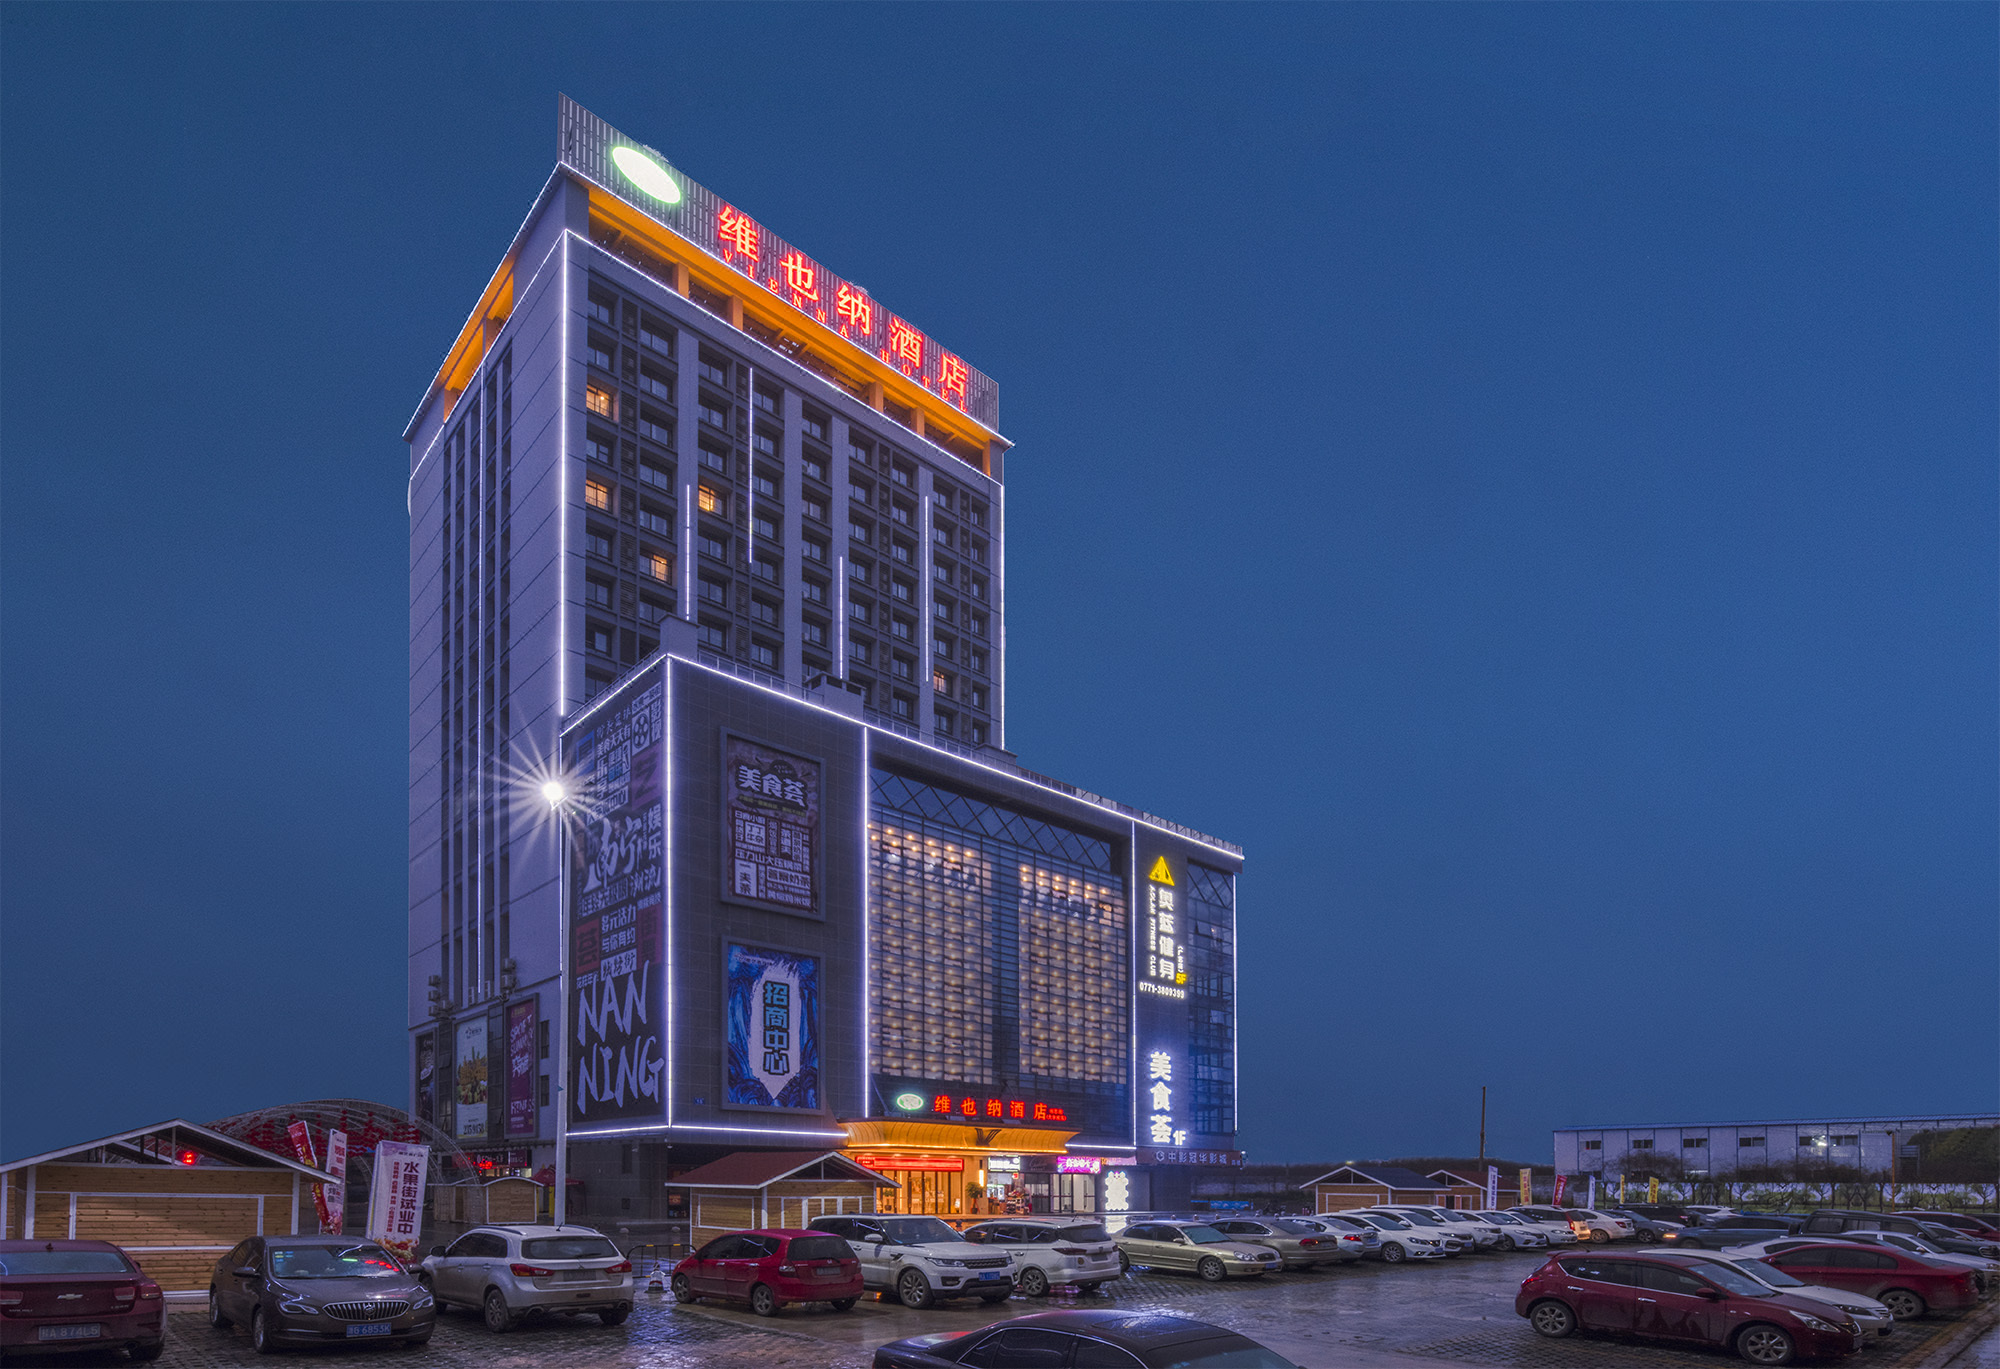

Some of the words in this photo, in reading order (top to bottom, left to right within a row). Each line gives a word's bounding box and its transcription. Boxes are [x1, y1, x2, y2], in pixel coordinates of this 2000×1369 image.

[718, 206, 969, 398] 维也纳酒店
[723, 249, 850, 338] VIENNA
[880, 350, 969, 413] HOTEL
[738, 765, 806, 807] 美食荟
[601, 903, 636, 934] 多元活力
[602, 926, 636, 953] 与你有约
[577, 960, 649, 1047] NAN
[1175, 972, 1187, 985] 5F
[764, 982, 789, 1075] 招商中心
[577, 1035, 664, 1114] NING
[934, 1095, 1047, 1120] 维也纳酒店
[1150, 1051, 1172, 1144] 美食荟
[1172, 1130, 1187, 1146] 1F
[397, 1161, 420, 1235] 水果街试业中
